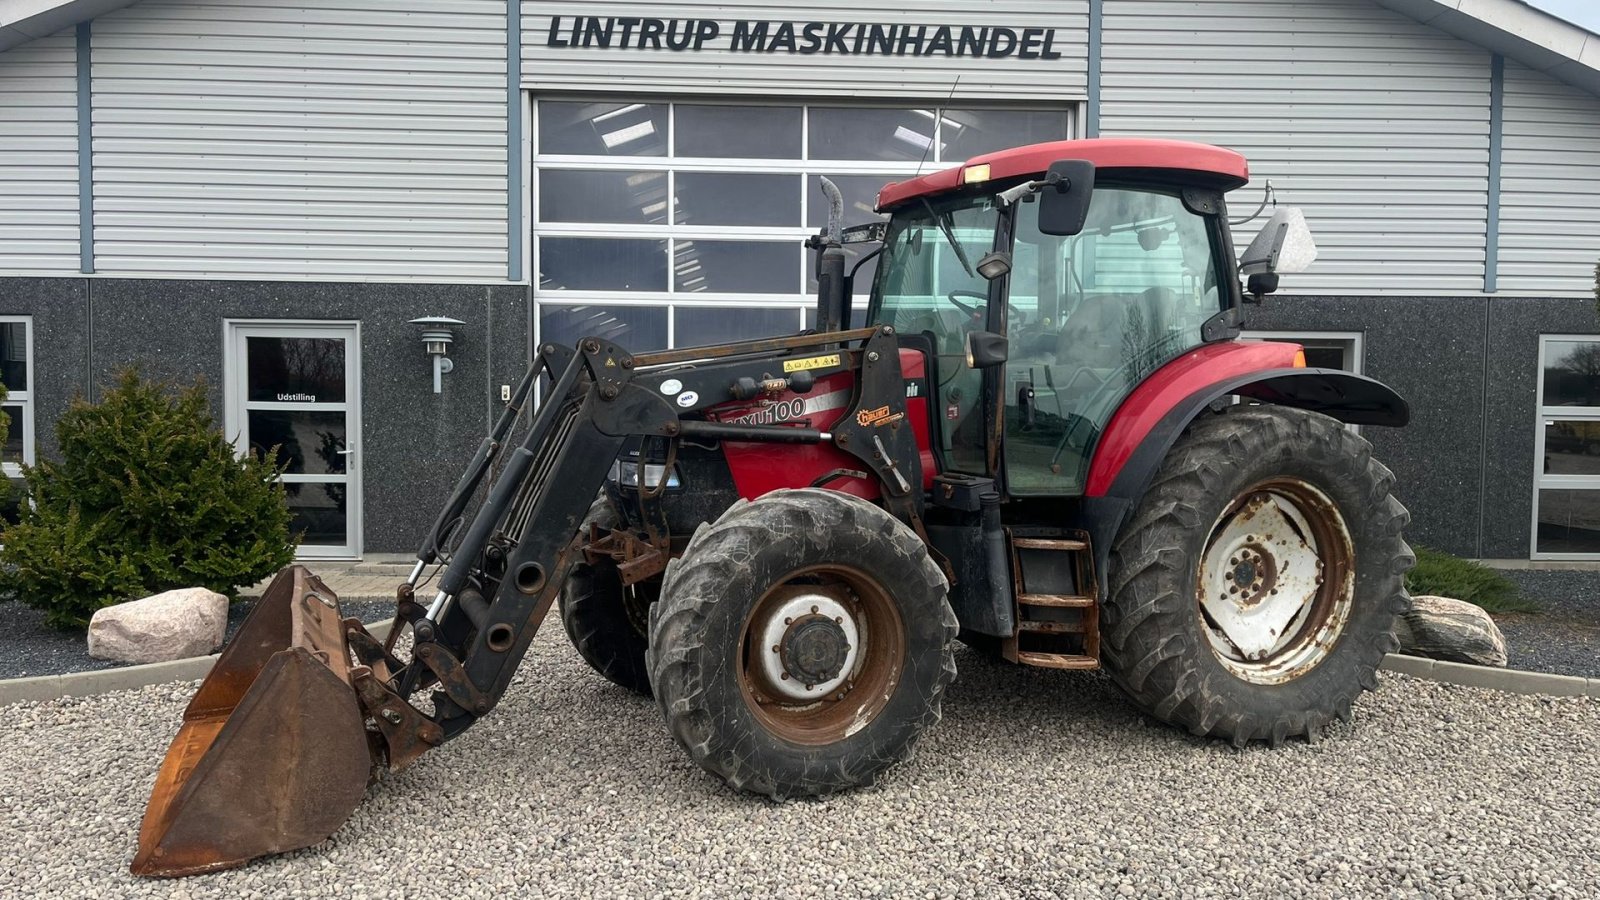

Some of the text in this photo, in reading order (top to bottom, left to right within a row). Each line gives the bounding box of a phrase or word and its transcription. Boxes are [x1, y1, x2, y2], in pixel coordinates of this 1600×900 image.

[547, 16, 1062, 59] LINTRUP MASKINHANDEL
[277, 393, 316, 403] Udstilling
[725, 397, 806, 425] XU100
